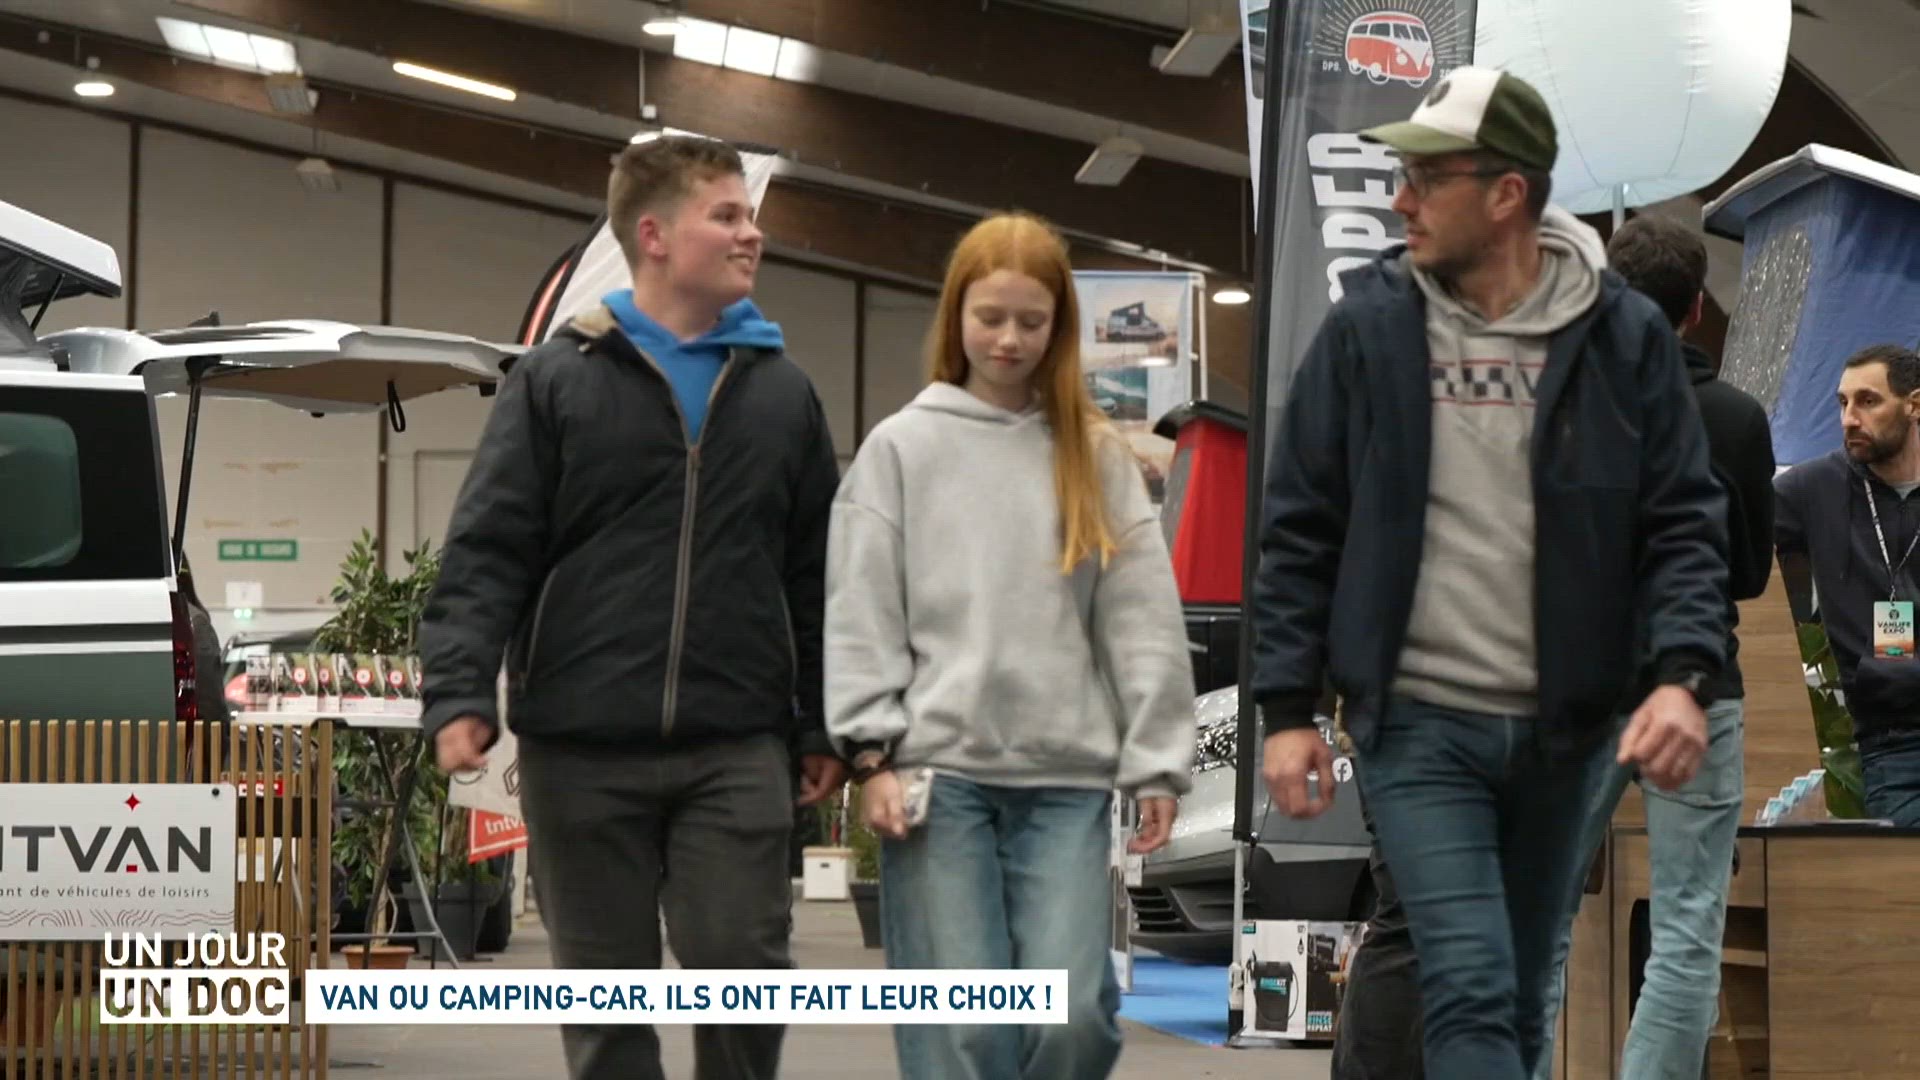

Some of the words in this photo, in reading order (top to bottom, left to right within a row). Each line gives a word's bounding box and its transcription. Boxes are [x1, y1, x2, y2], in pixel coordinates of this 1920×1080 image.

[0, 826, 212, 873] TVAN
[30, 885, 50, 898] de
[57, 885, 131, 898] véhicules
[137, 886, 156, 898] de
[162, 886, 210, 898] loisirs
